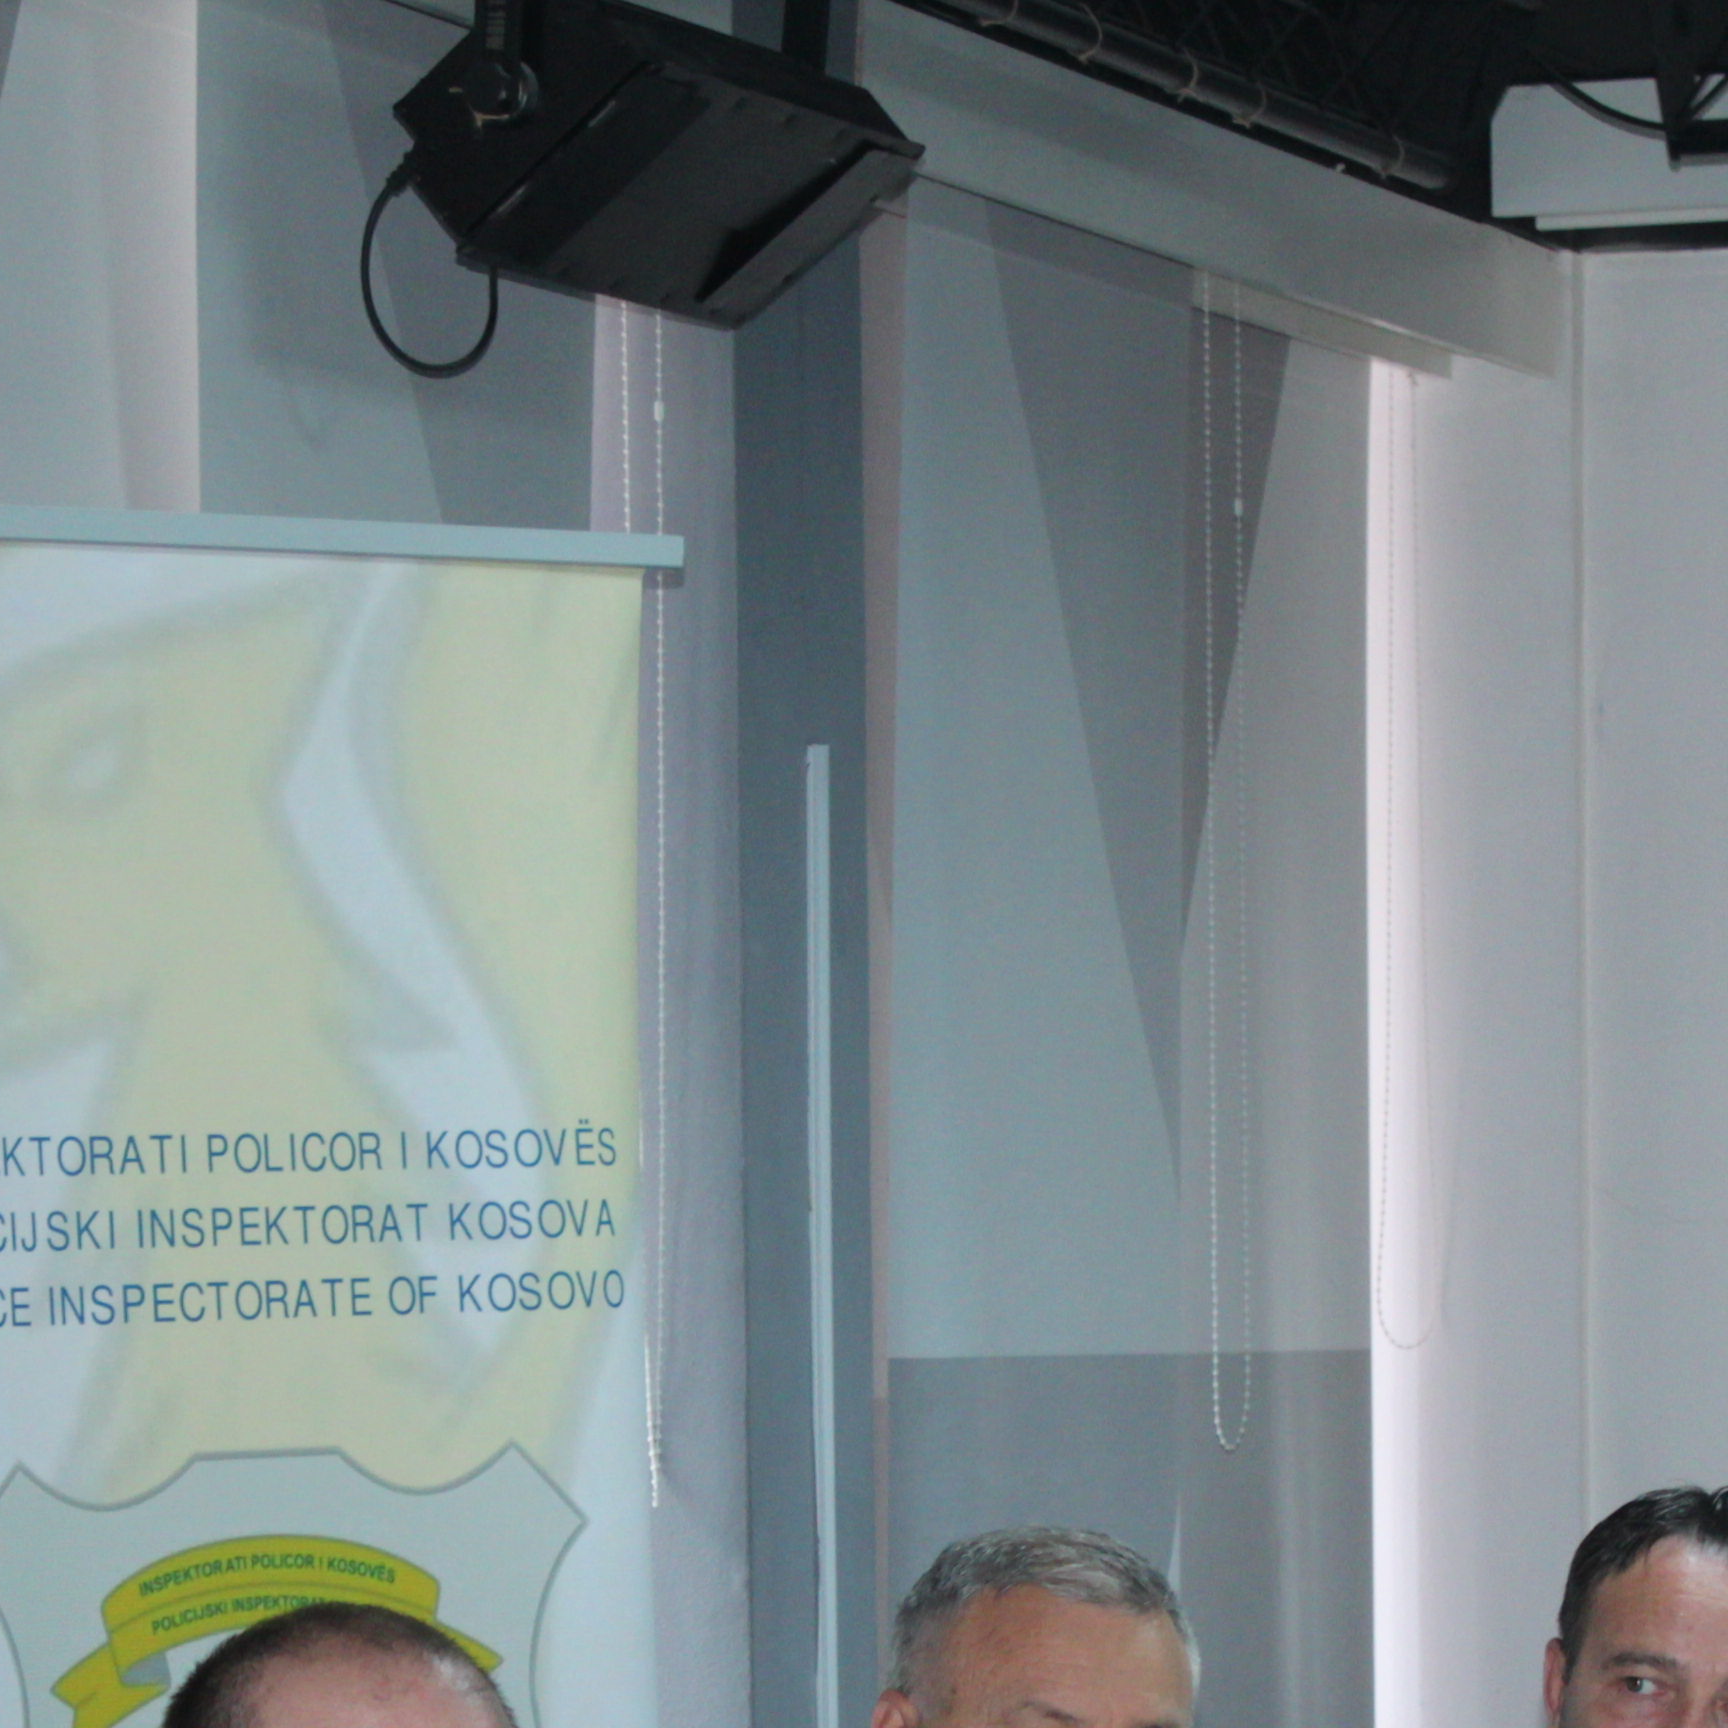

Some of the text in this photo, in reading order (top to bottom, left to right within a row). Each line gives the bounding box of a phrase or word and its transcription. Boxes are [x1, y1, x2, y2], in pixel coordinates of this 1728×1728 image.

[207, 1131, 382, 1173] POLICOR
[400, 1131, 407, 1169] I
[426, 1119, 616, 1169] KOSOVËS
[137, 1203, 428, 1248] INSPEKTORAT
[449, 1199, 615, 1240] KOSOVA
[49, 1277, 372, 1325] INSPECTORATE
[388, 1275, 437, 1315] OF
[458, 1269, 624, 1312] KOSOVO
[252, 1553, 315, 1570] POLICOR
[153, 1604, 227, 1633] POLICIJSKI
